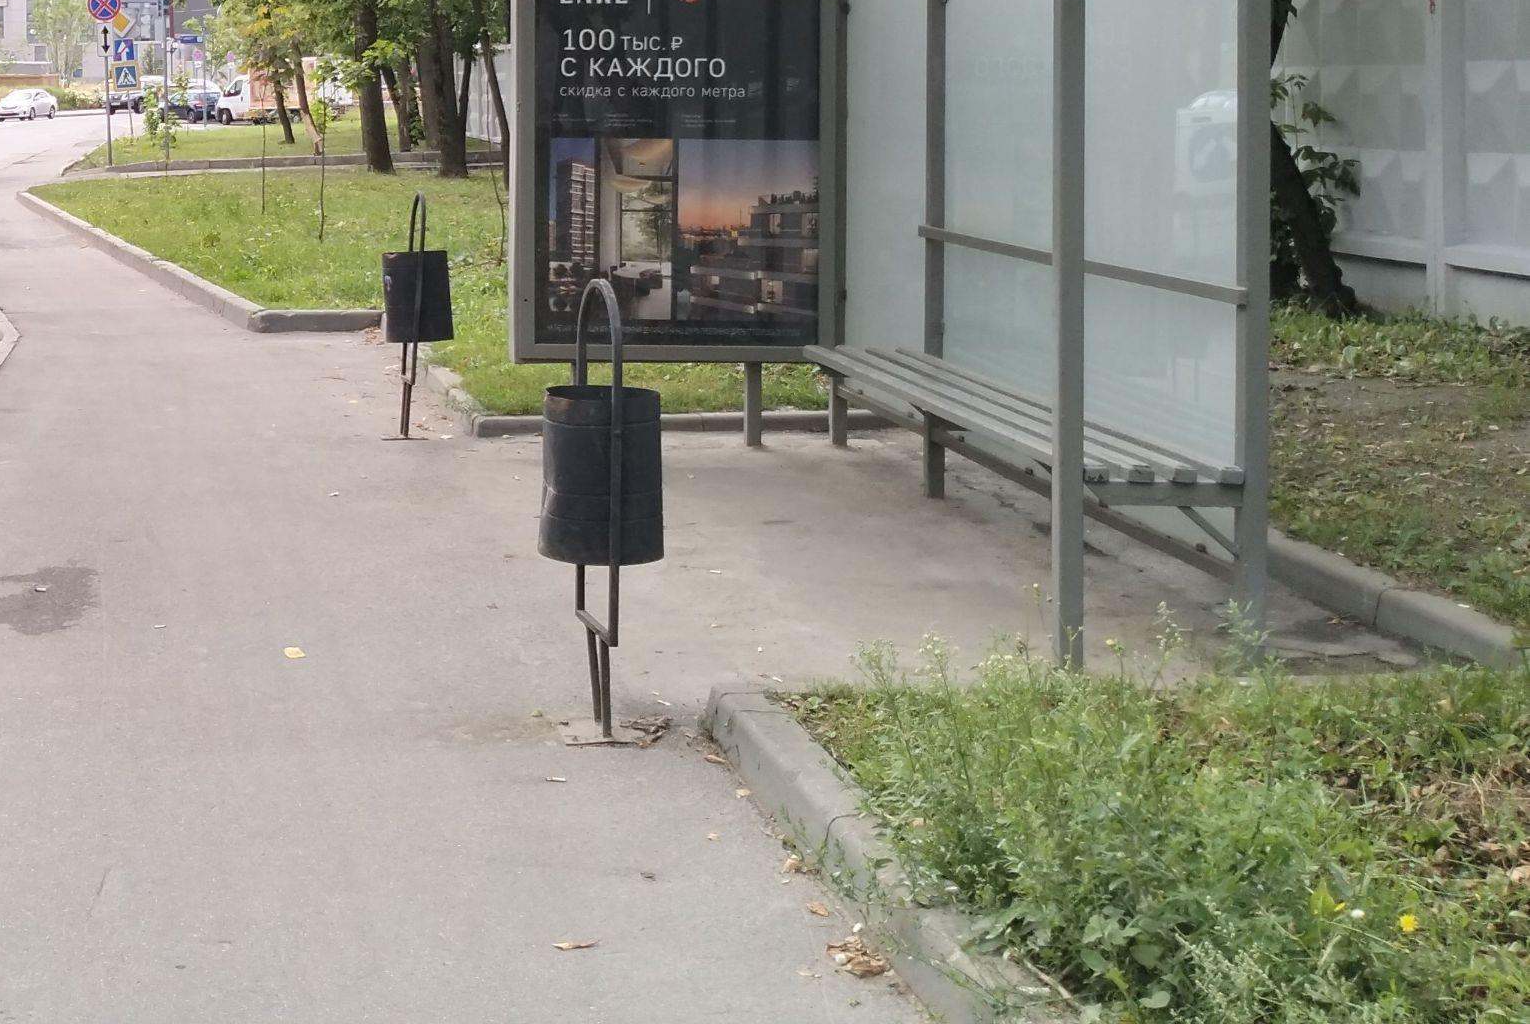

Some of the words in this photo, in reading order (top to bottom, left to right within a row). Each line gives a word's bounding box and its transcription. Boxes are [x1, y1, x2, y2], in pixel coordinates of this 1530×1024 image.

[563, 29, 615, 52] 100
[560, 57, 578, 78] С
[589, 57, 727, 81] КАЖДОГО
[559, 85, 611, 99] скидка
[617, 86, 626, 97] с
[632, 85, 695, 99] каждого
[701, 87, 747, 100] метра
